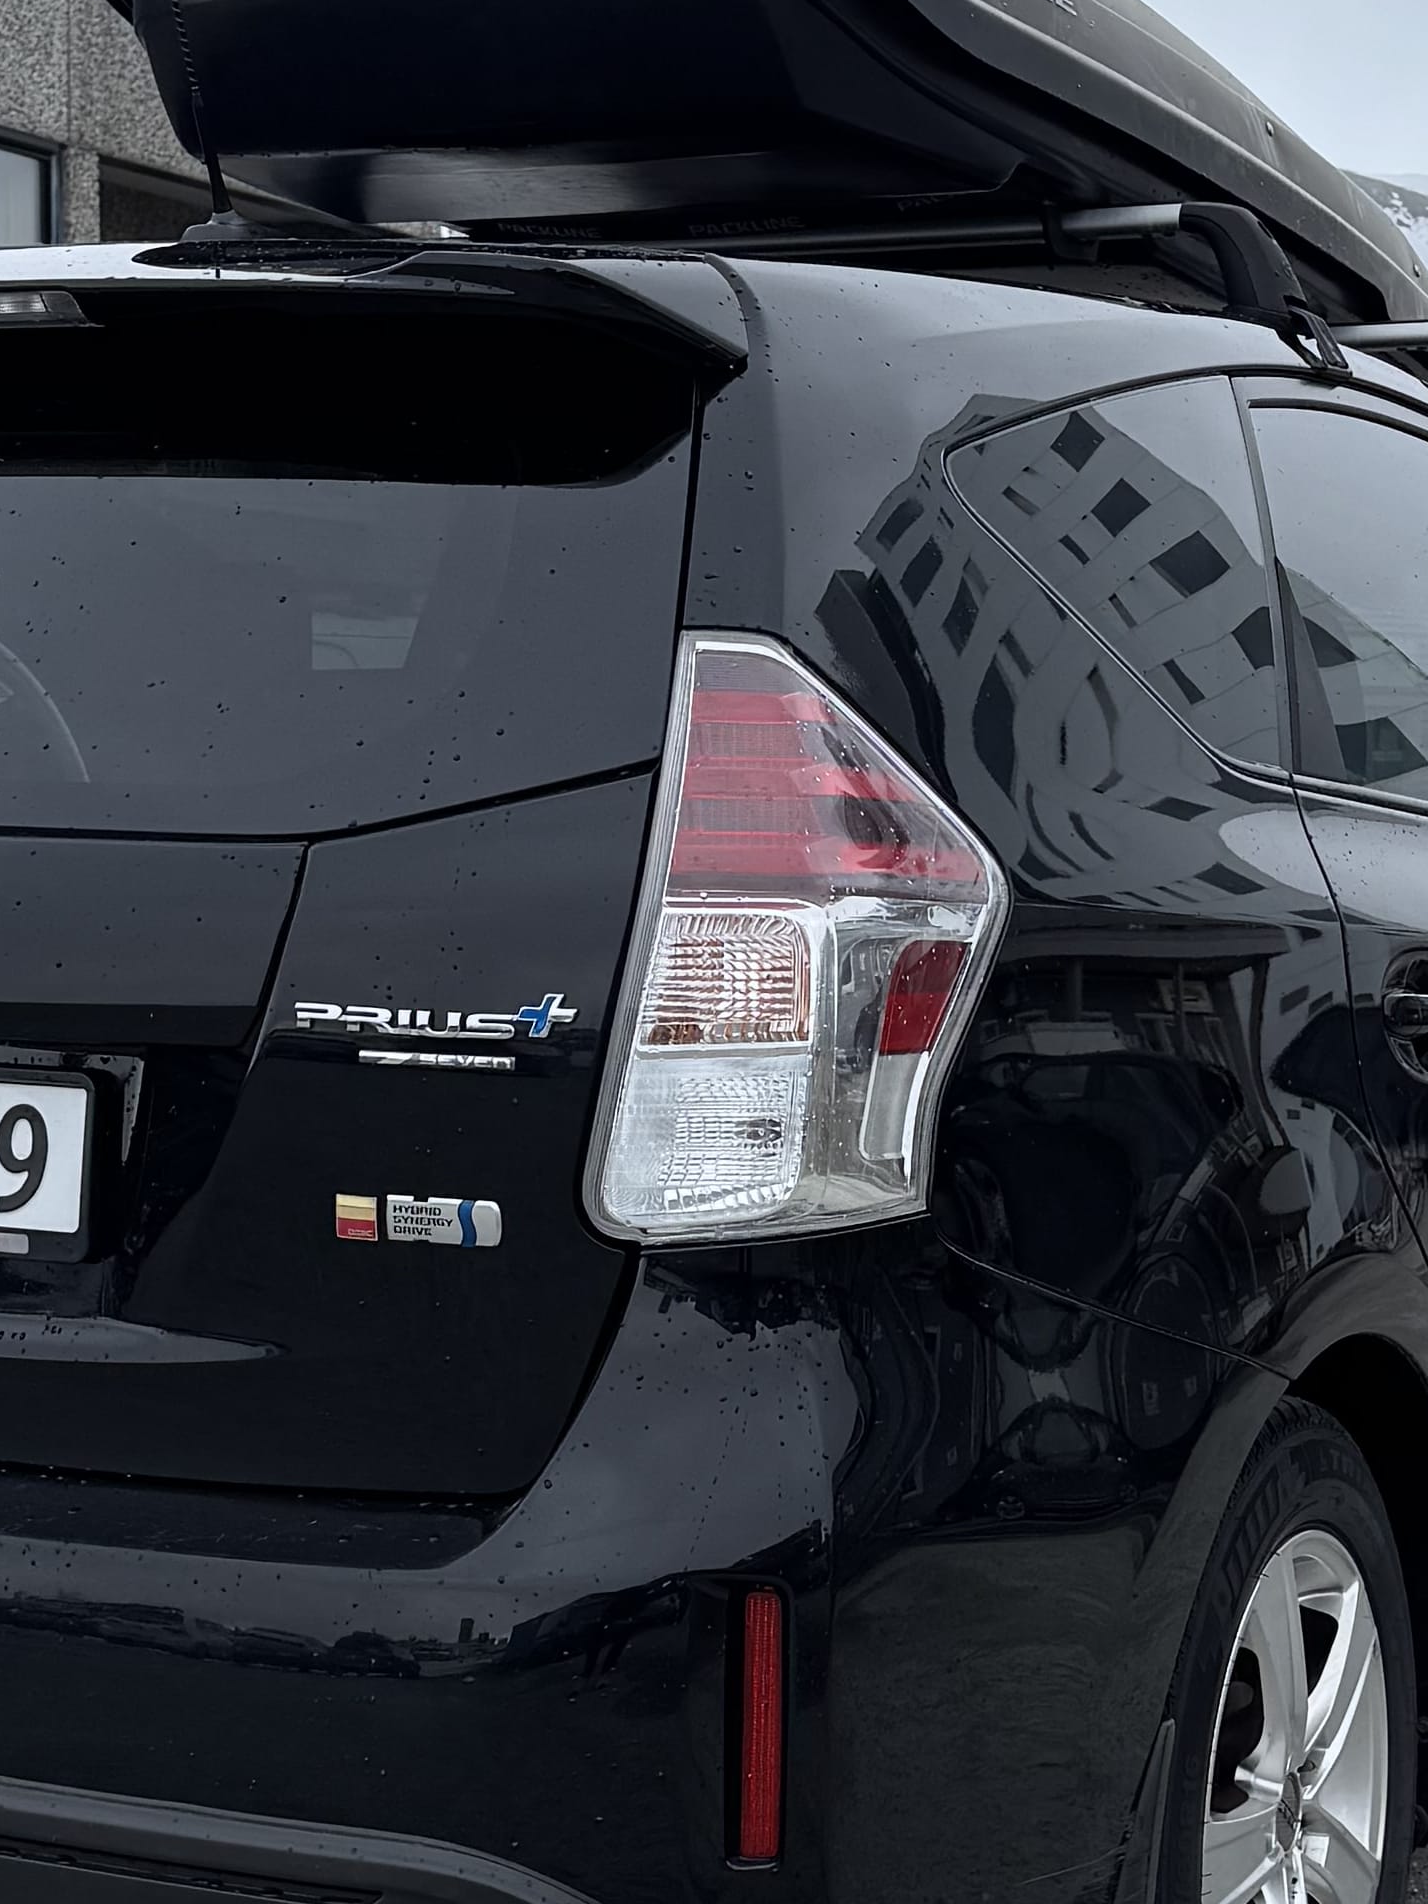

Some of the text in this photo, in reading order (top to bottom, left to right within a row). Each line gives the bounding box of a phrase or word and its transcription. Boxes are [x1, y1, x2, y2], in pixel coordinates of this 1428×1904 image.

[687, 216, 805, 237] PACKLINE
[392, 1204, 442, 1217] HYBRID
[393, 1215, 453, 1228] SYNERGY
[393, 1227, 433, 1237] DRIVE
